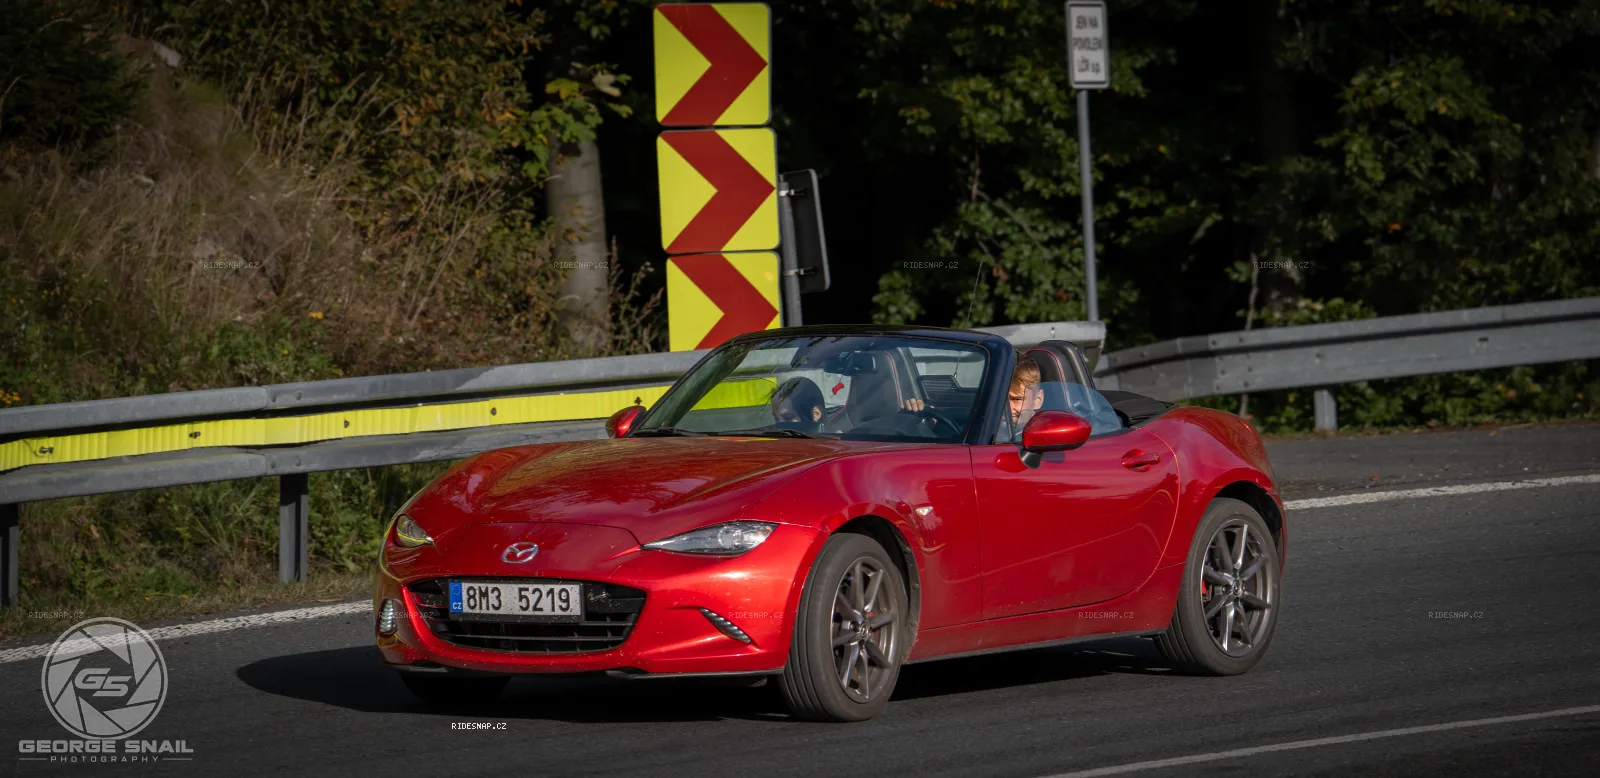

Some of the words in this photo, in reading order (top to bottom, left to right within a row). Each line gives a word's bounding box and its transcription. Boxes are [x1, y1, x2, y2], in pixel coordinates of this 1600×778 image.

[452, 602, 462, 610] CZ
[466, 586, 502, 611] 8M3
[518, 587, 571, 612] 5219
